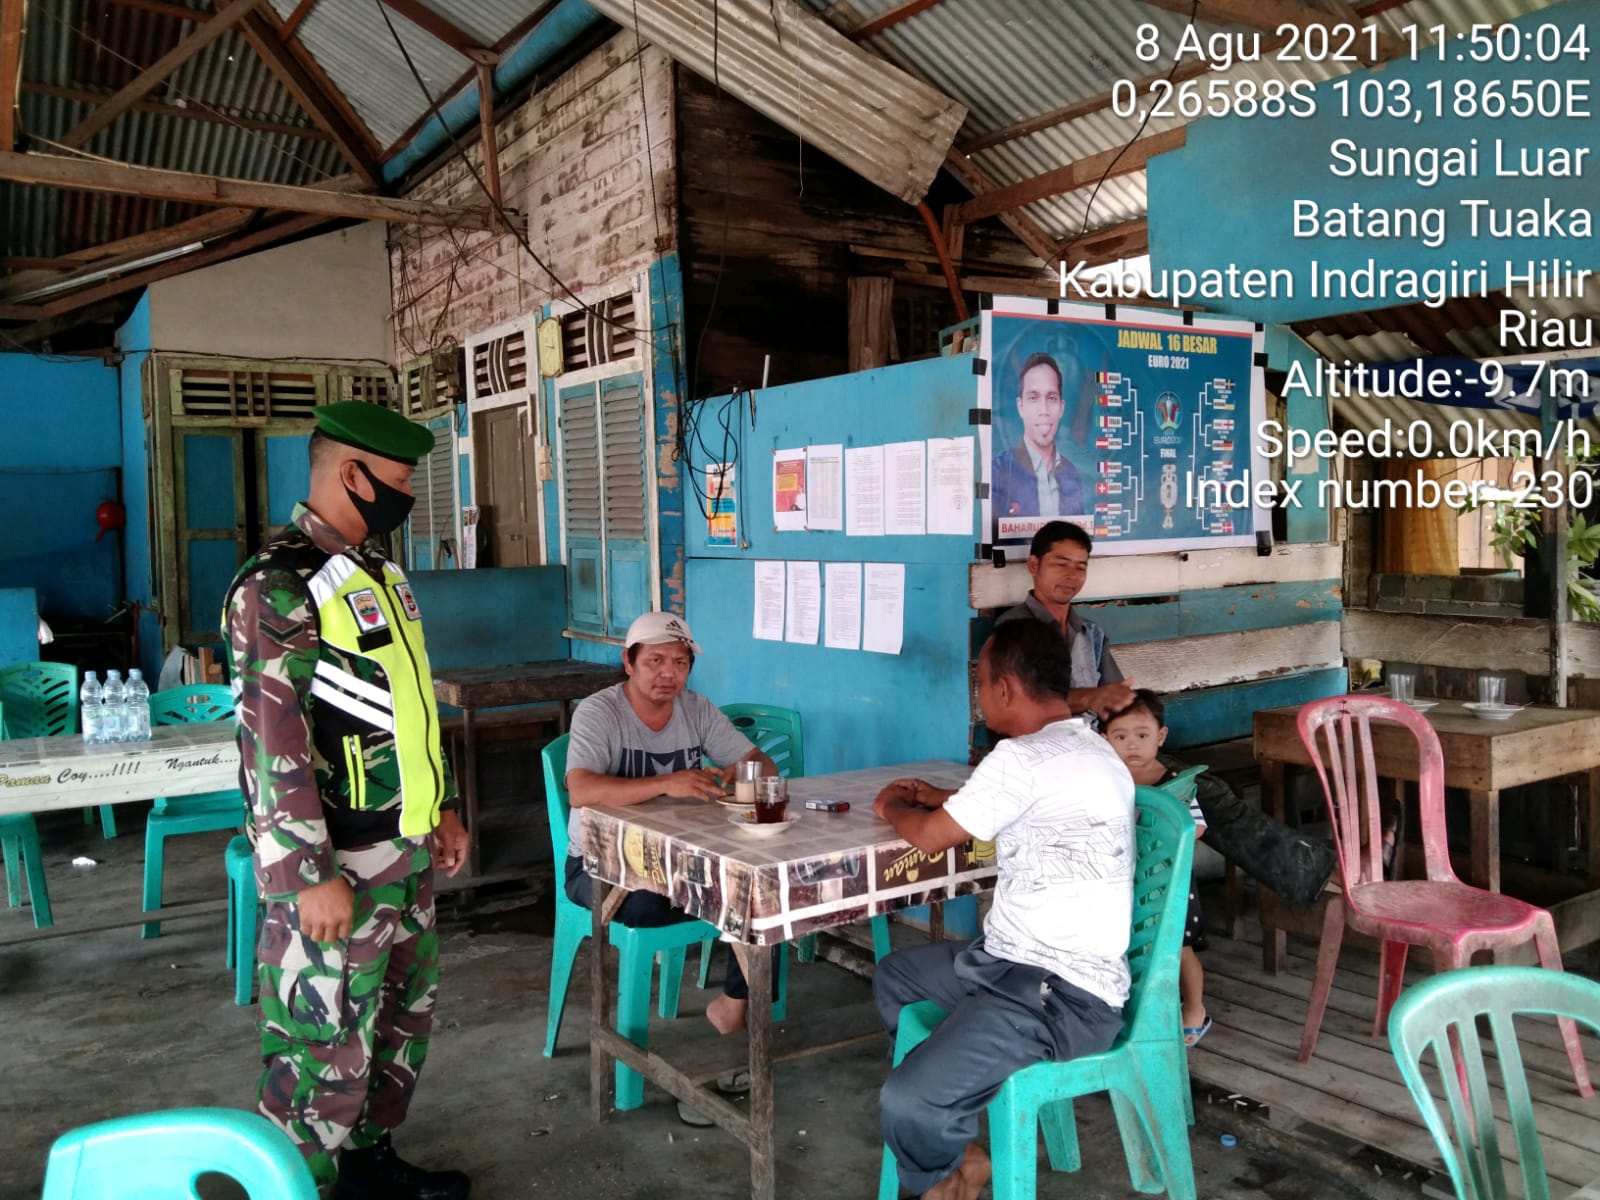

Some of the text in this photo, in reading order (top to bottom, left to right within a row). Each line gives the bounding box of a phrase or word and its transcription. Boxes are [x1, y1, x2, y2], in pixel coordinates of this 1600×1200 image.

[1117, 329, 1217, 354] JADWAL 16 BESAR
[1148, 354, 1189, 370] EURO 2021
[1159, 447, 1177, 459] FINAL
